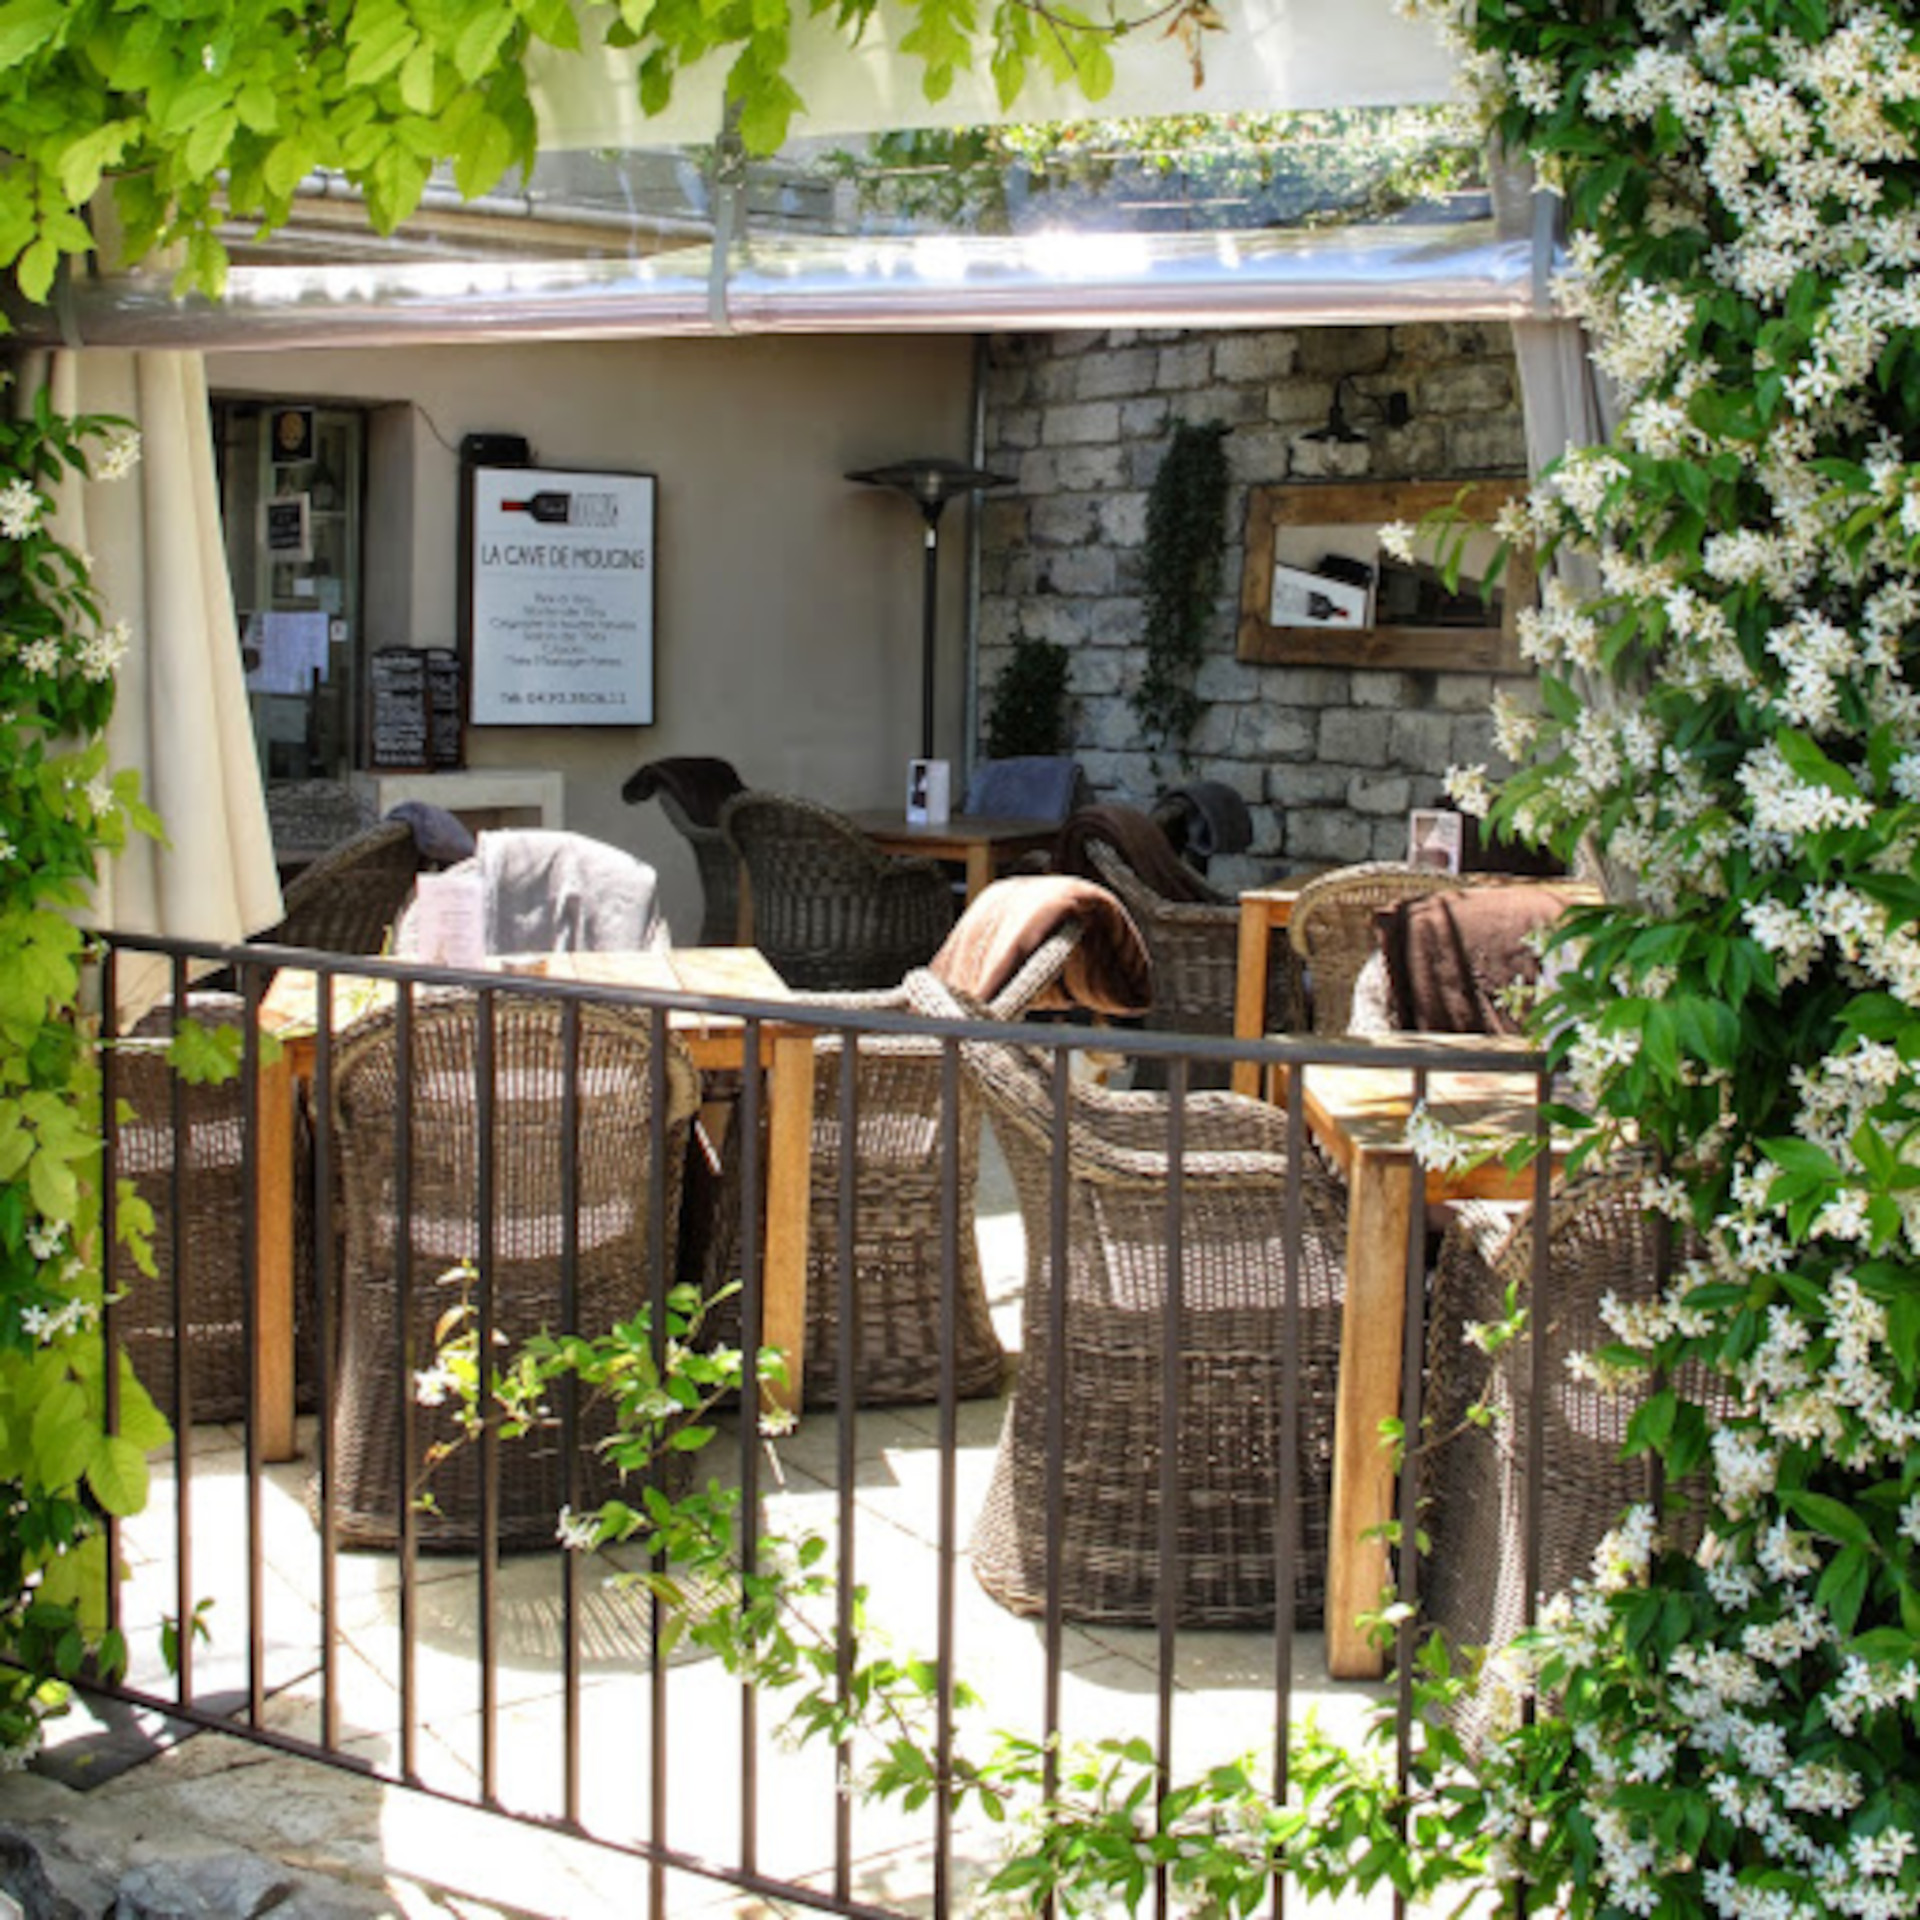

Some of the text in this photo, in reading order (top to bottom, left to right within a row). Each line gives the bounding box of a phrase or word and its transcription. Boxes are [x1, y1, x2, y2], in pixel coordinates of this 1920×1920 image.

[481, 545, 645, 570] LA CAVE DE MOUGINS
